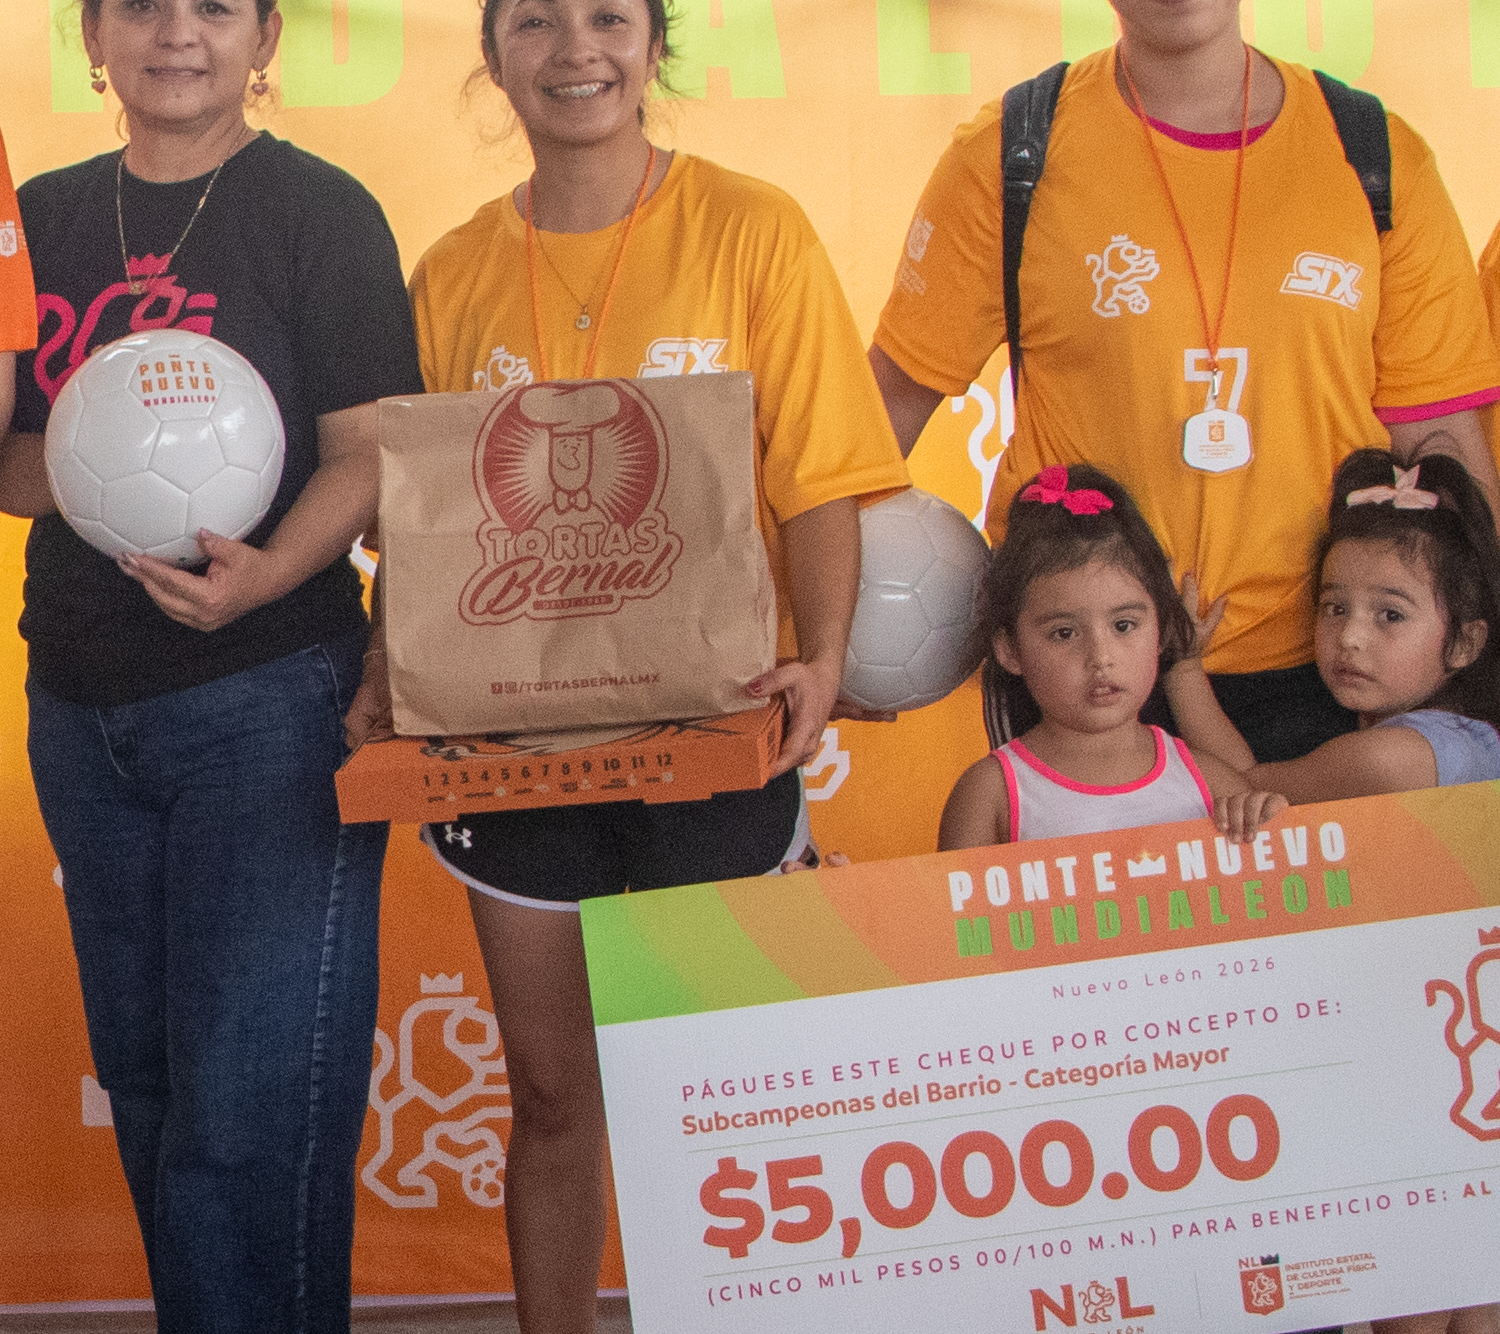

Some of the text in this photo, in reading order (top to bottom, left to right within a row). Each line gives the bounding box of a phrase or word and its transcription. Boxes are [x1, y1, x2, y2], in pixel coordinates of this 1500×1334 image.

[1280, 251, 1364, 311] SIX
[138, 356, 213, 378] PONTE
[141, 375, 217, 394] NUEVO
[486, 518, 659, 564] TORTAS
[468, 542, 674, 616] Bernal
[947, 820, 1348, 913] PONTE NUEVO
[1052, 956, 1276, 1000] Nuevo León 2026
[681, 999, 1343, 1103] PÁGUESE ESTE CHEQUE POR CONCEPTO DE:
[681, 1046, 1231, 1136] Subcampeonas del Barrio Categoría Mayor
[699, 1093, 1281, 1260] $5,000.00
[706, 1275, 803, 1308] (CINCO
[818, 1268, 864, 1289] MIL
[877, 1254, 962, 1281] PESOS
[976, 1239, 1073, 1268] 00/100
[1087, 1226, 1158, 1252] M.N.)
[1171, 1216, 1238, 1240] PARA
[1251, 1193, 1393, 1229] BENEFICIO
[1407, 1187, 1450, 1207] DE:
[1461, 1177, 1493, 1199] AL
[1285, 1251, 1376, 1271] INSTITUTO ESTATAL
[1286, 1273, 1300, 1282] DE
[1302, 1267, 1345, 1280] CULTURA
[1297, 1276, 1342, 1290] DEPORTE
